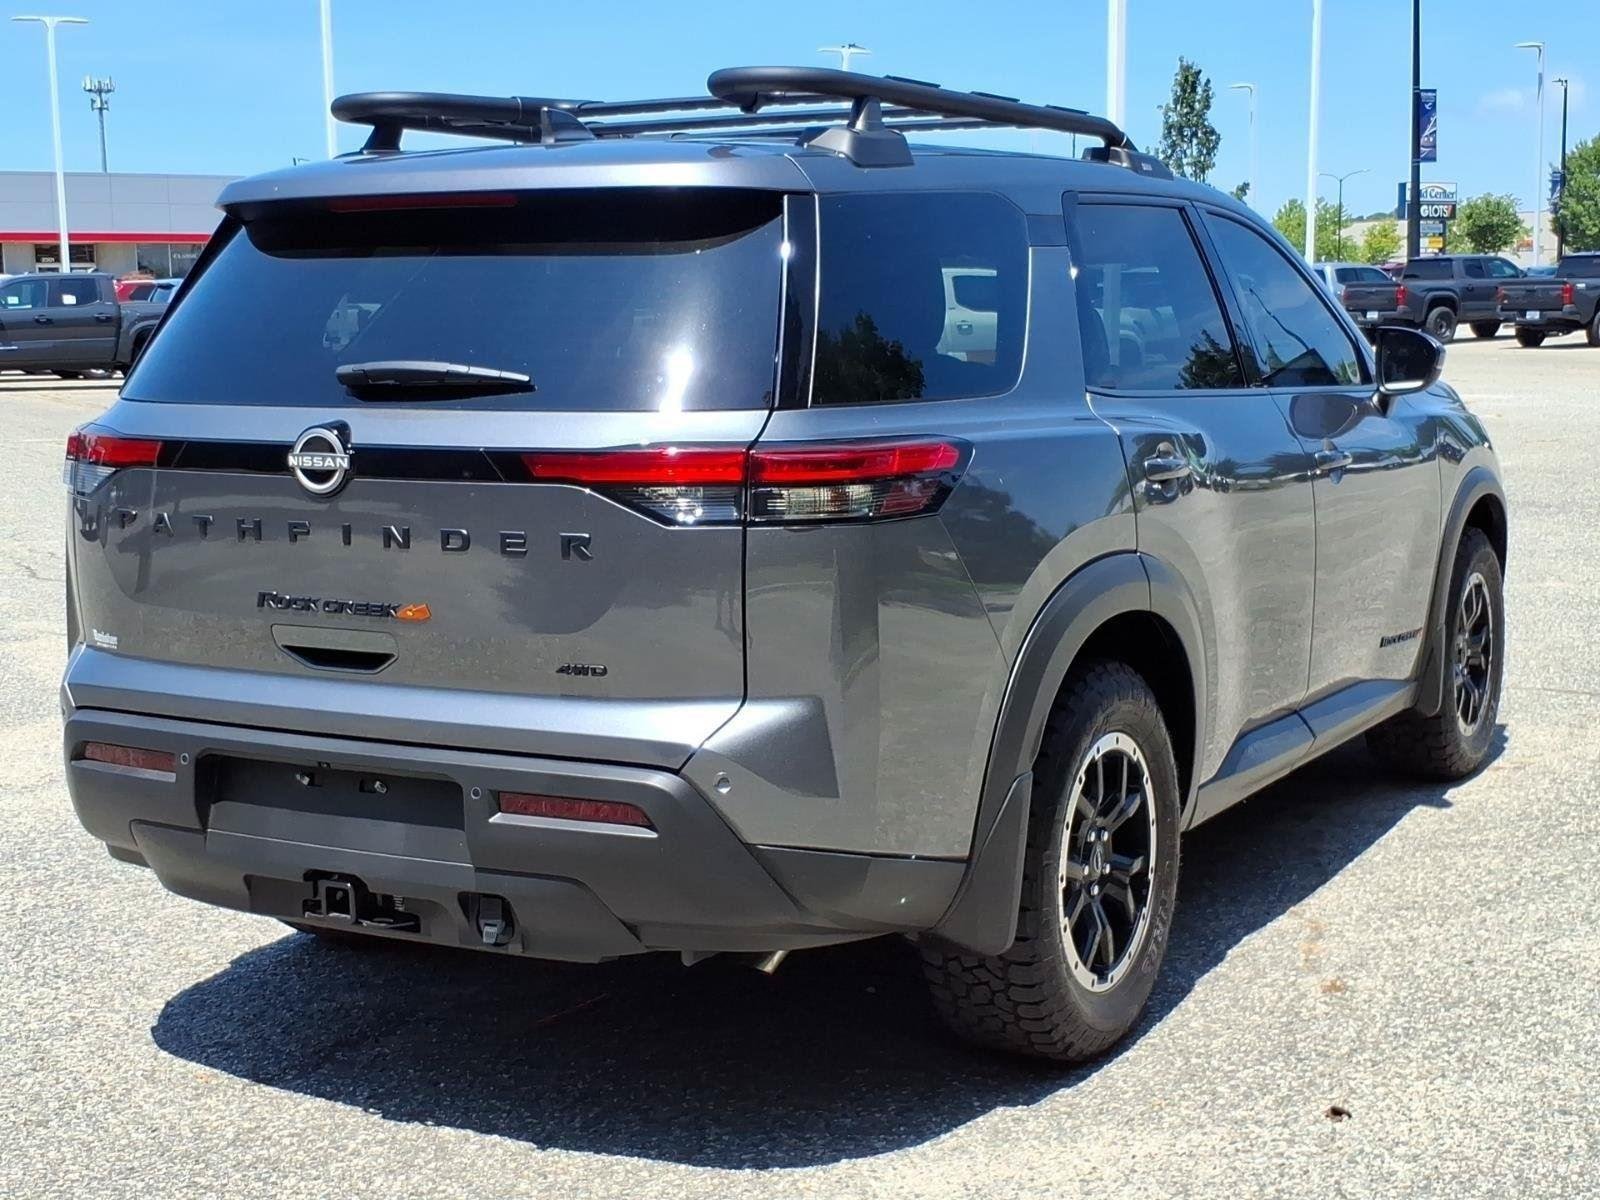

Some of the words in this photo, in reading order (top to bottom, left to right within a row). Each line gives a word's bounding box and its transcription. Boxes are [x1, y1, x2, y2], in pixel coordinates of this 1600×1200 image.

[288, 455, 348, 469] NISSAN
[117, 507, 594, 562] PATHFINDER
[322, 599, 402, 618] CREEK
[555, 662, 608, 677] 4WD
